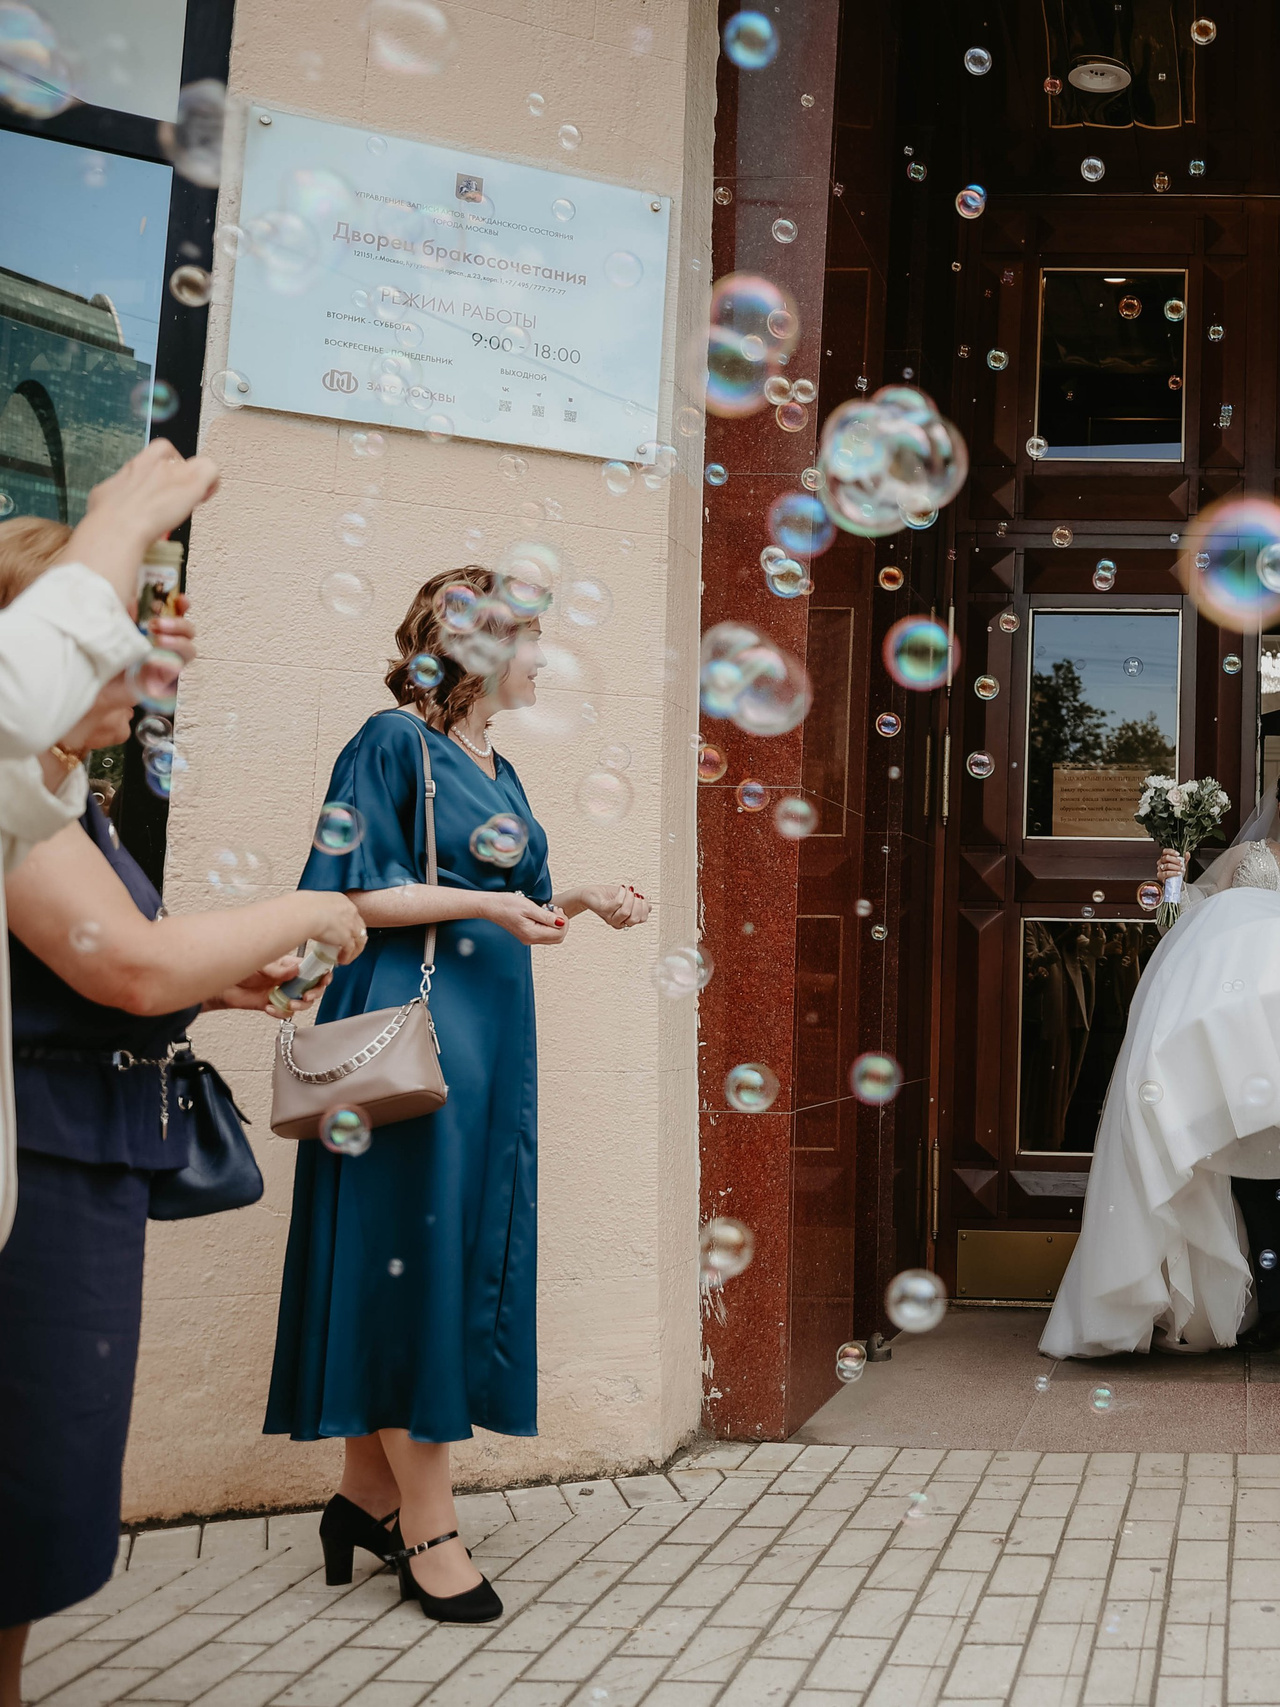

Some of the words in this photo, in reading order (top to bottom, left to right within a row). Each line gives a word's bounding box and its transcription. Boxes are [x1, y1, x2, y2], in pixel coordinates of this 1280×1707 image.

[355, 190, 405, 206] УПРАВЛЕНИЕ
[406, 201, 440, 212] ЗАПИСИ
[468, 214, 528, 232] ГРАЖДАНСКОГО
[528, 226, 574, 240] СОСТОЯНИЯ
[433, 218, 464, 230] ГОРОДА
[465, 224, 498, 236] МОСКВЫ
[332, 221, 415, 254] Дворец
[422, 238, 588, 286] бракосочетания
[326, 311, 366, 324] ВТОРНИК
[374, 320, 412, 332] СУББОТА
[381, 288, 455, 314] РЕЖИМ
[462, 302, 537, 330] РАБОТЫ
[324, 338, 384, 354] ВОСКРЕСЕНЬЕ
[390, 349, 454, 366] ПОНЕДЕЛЬНИК
[472, 332, 513, 352] 9:00
[534, 342, 581, 364] 18:00
[500, 368, 547, 381] ВЫХОДНОЙ
[366, 382, 397, 395] ЗАГС
[400, 388, 456, 404] МОСКВЫ
